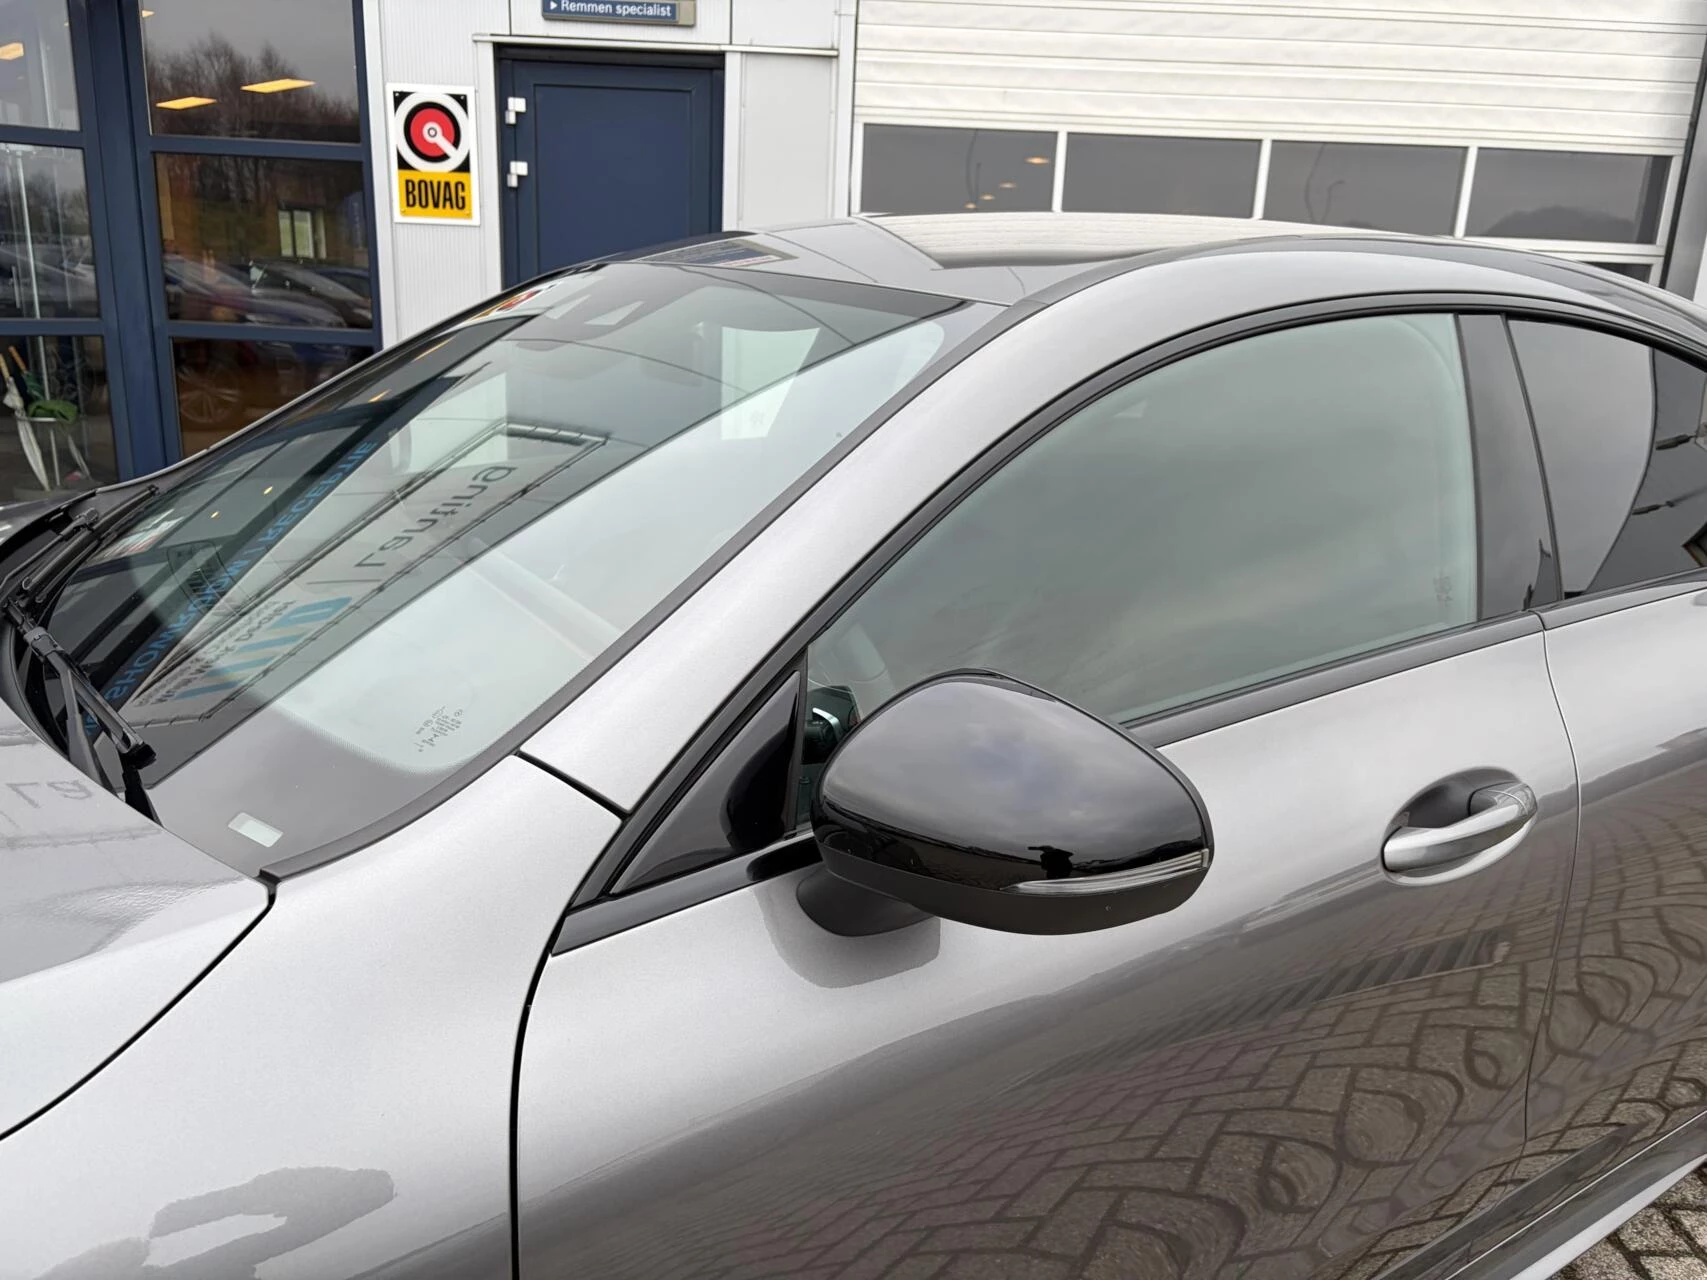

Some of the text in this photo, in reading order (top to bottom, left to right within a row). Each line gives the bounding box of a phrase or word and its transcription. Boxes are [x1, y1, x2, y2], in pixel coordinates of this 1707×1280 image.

[561, 1, 672, 16] Remmen specialist
[405, 178, 466, 210] BOVAG
